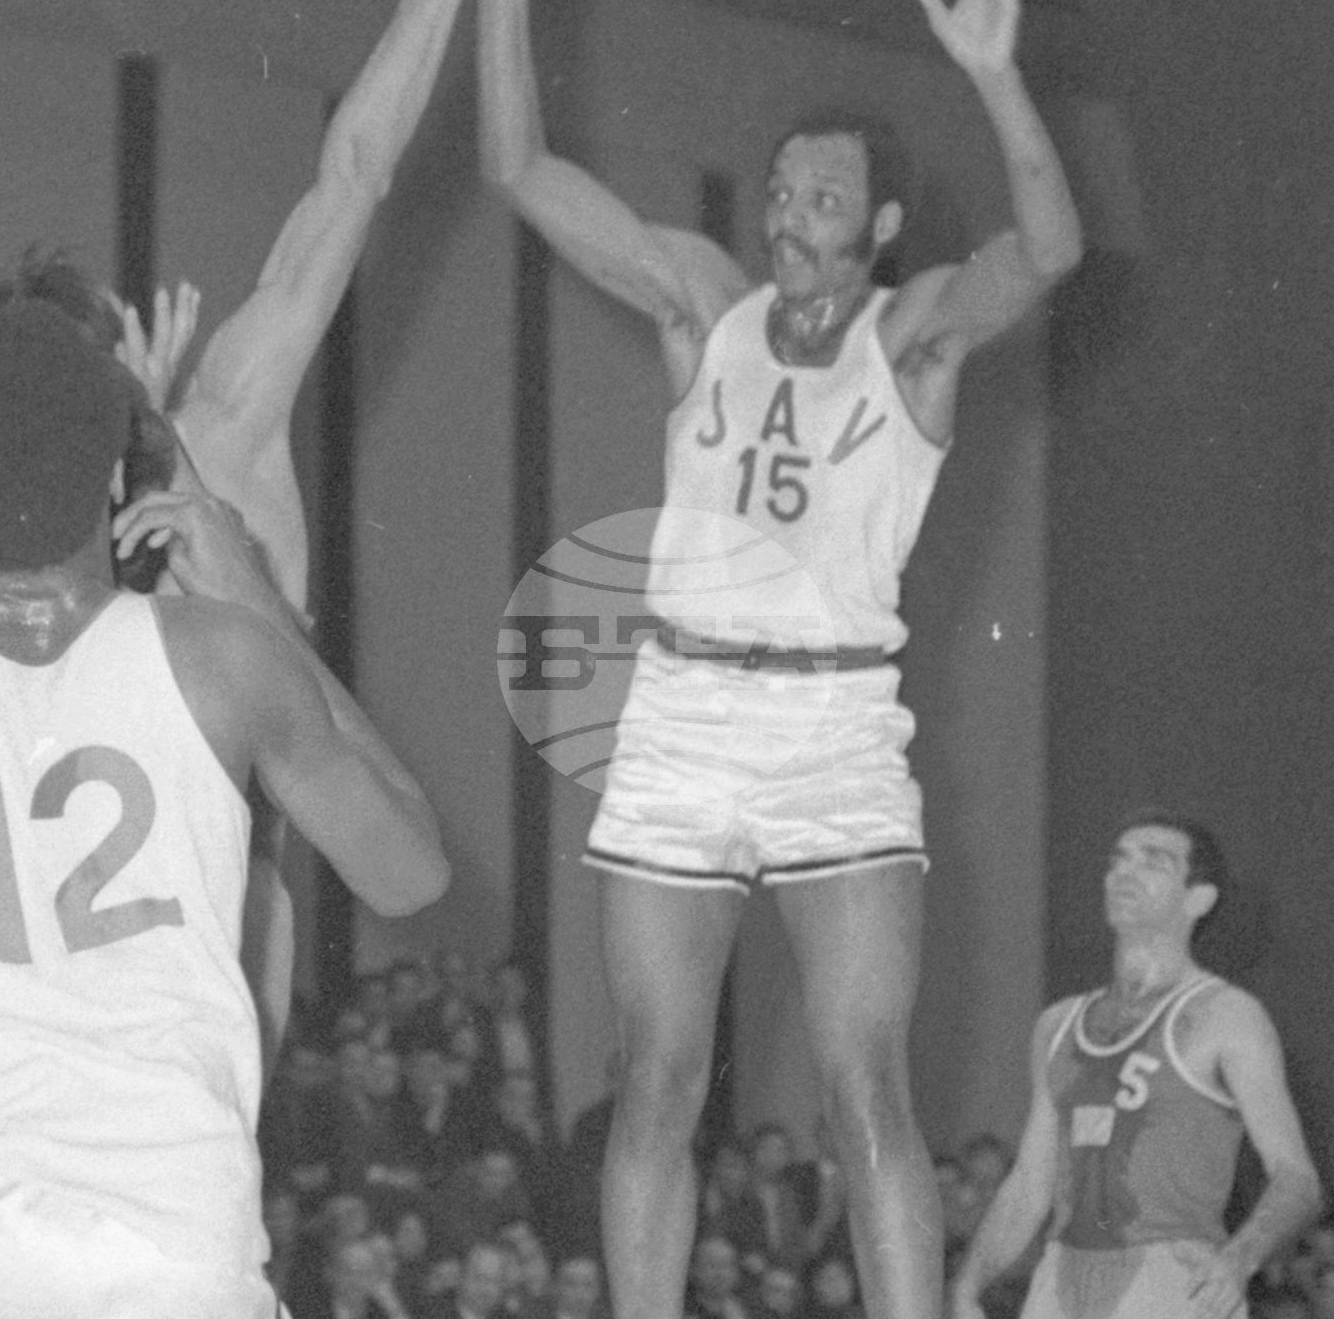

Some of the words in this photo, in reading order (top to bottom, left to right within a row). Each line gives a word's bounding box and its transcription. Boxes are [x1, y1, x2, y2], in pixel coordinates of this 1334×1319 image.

[696, 377, 888, 466] JAV
[735, 447, 811, 524] 15
[1116, 1051, 1162, 1111] 5
